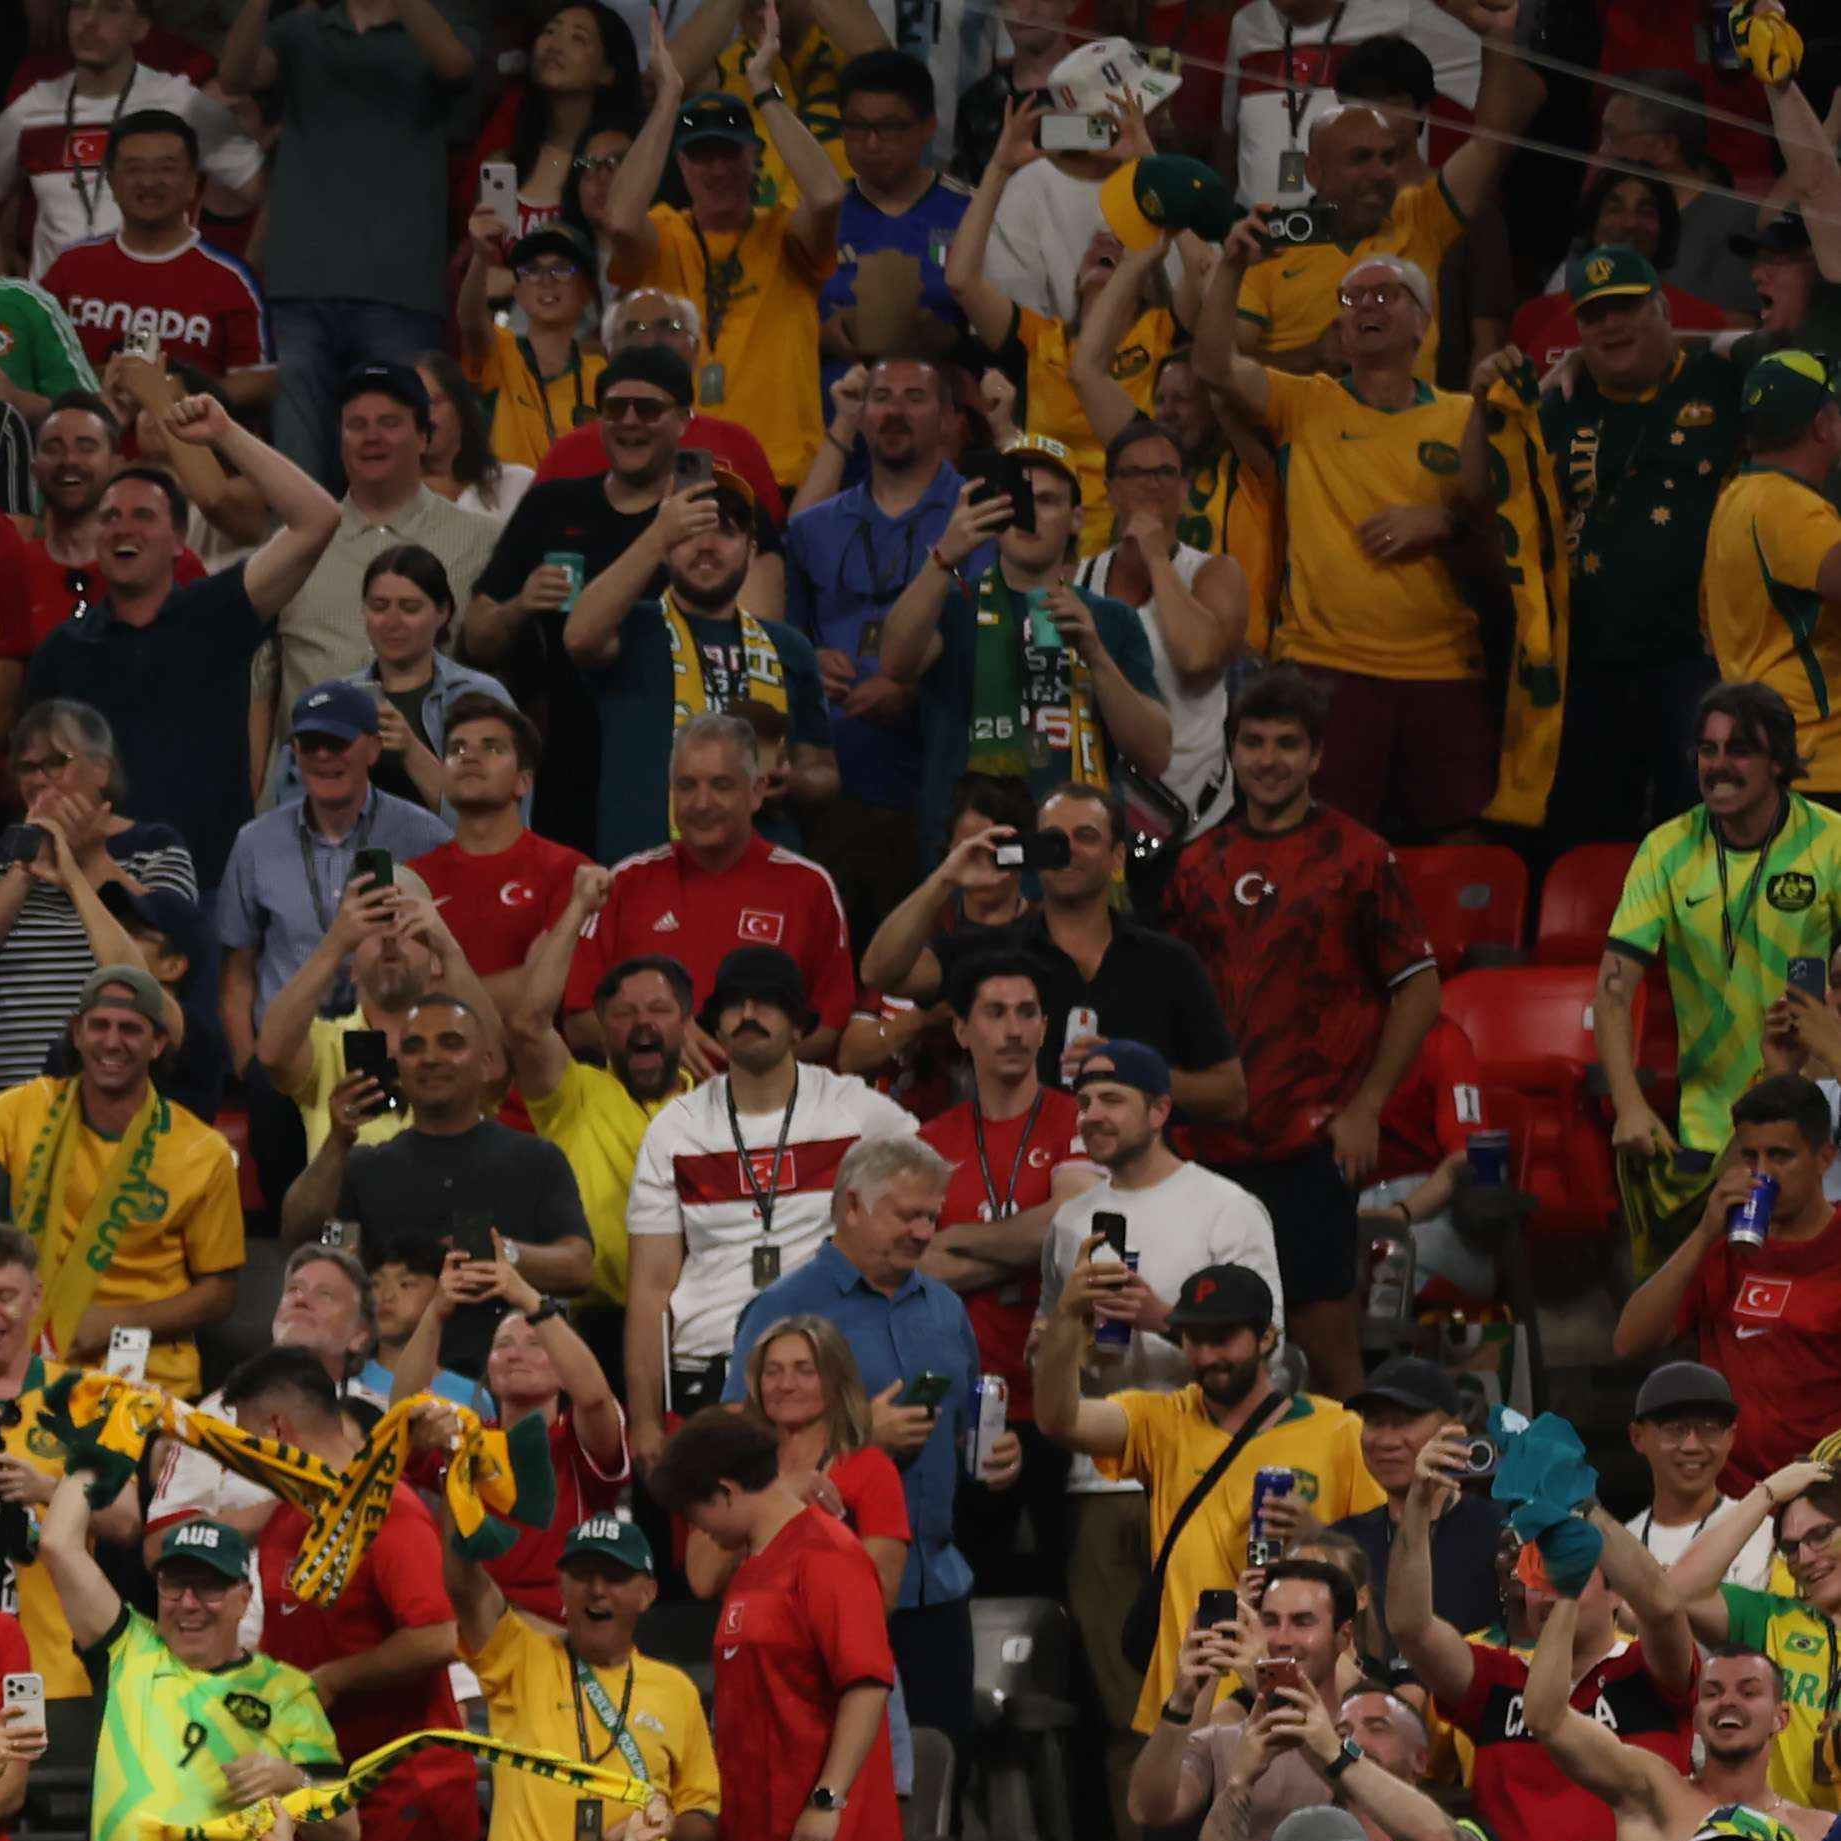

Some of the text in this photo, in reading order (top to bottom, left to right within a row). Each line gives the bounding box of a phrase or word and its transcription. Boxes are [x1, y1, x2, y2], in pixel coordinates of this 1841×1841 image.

[68, 296, 213, 348] CANADA
[969, 714, 1015, 741] 26
[173, 1525, 221, 1550] AUS
[577, 1518, 622, 1543] AUS
[178, 1721, 208, 1769] 9
